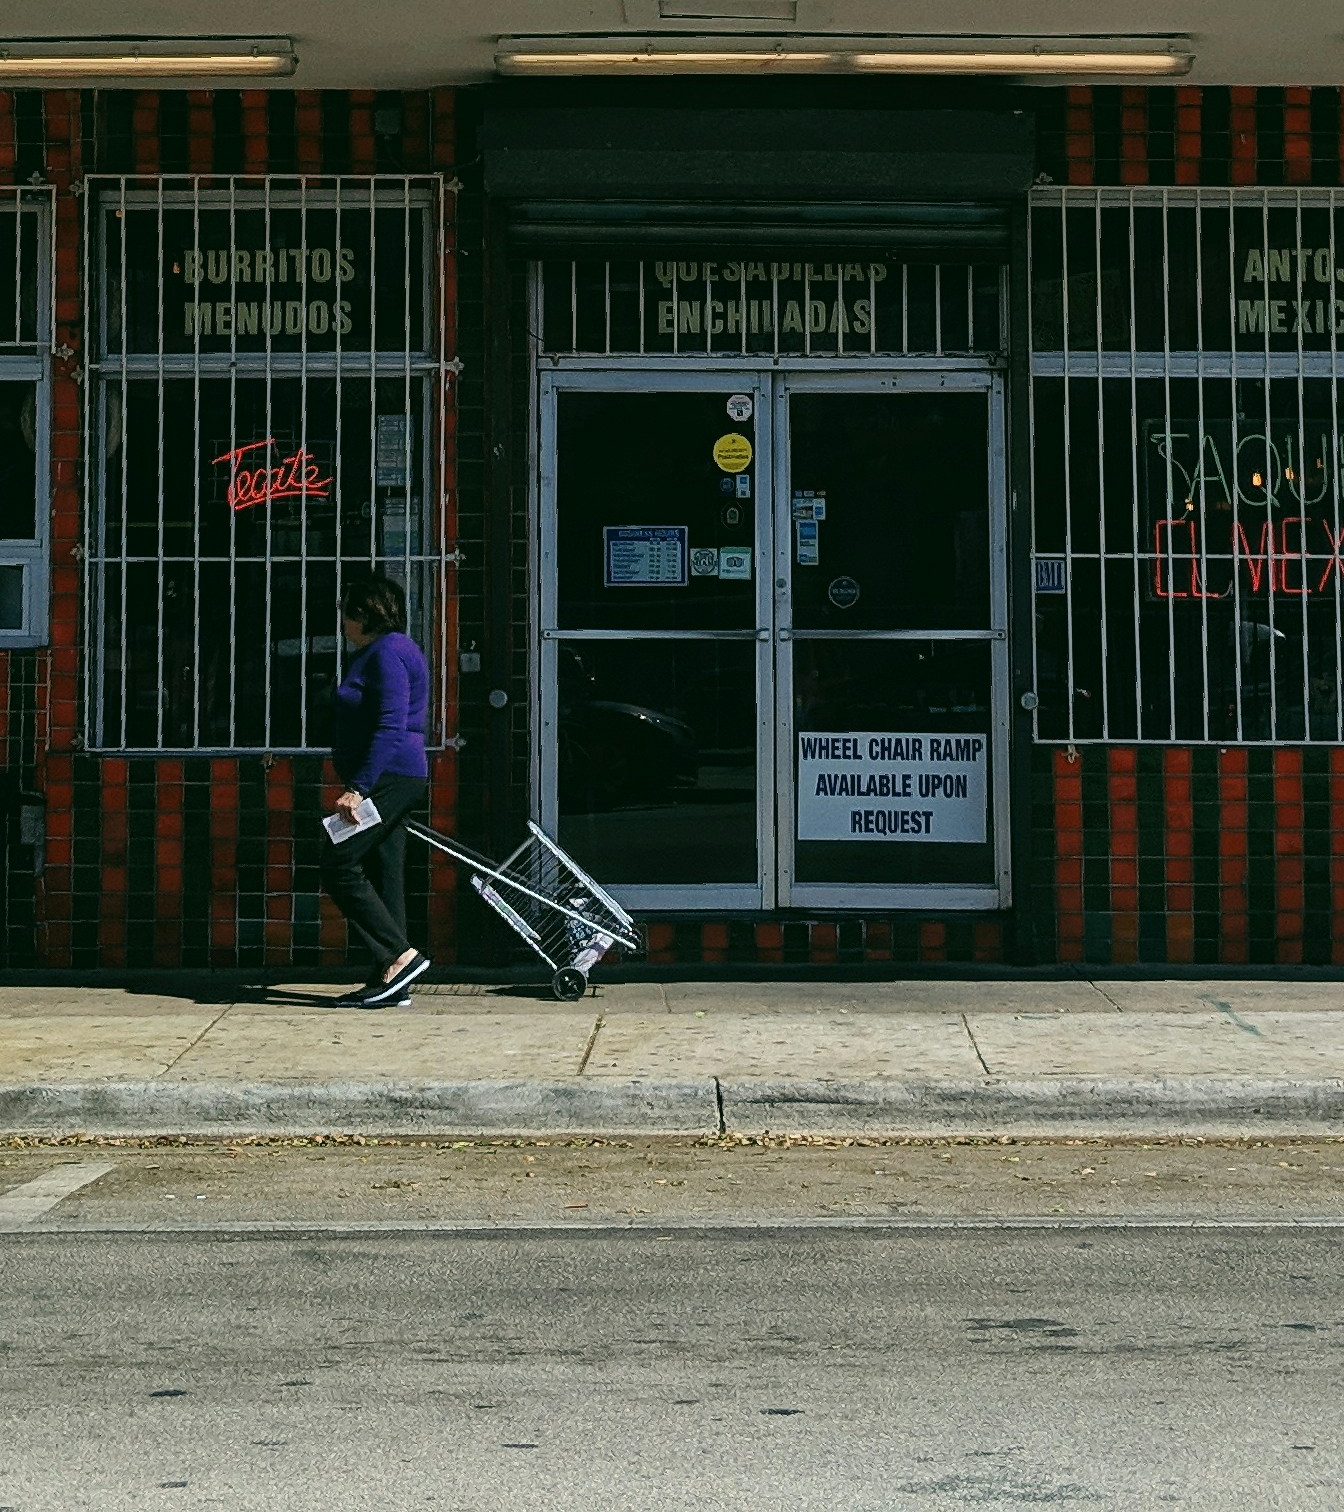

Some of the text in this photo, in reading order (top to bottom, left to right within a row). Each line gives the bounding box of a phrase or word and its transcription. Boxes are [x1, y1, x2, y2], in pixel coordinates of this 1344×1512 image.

[183, 247, 356, 284] BURRITOS
[655, 262, 888, 287] QUESADILLAS
[183, 299, 353, 337] MENUDOS
[658, 299, 874, 335] ENCHILADAS
[212, 439, 334, 506] Tecate
[801, 737, 984, 763] WHEEL CHAIR RAMP
[814, 773, 968, 799] AVAILABLE UPON
[850, 809, 934, 836] REQUEST
